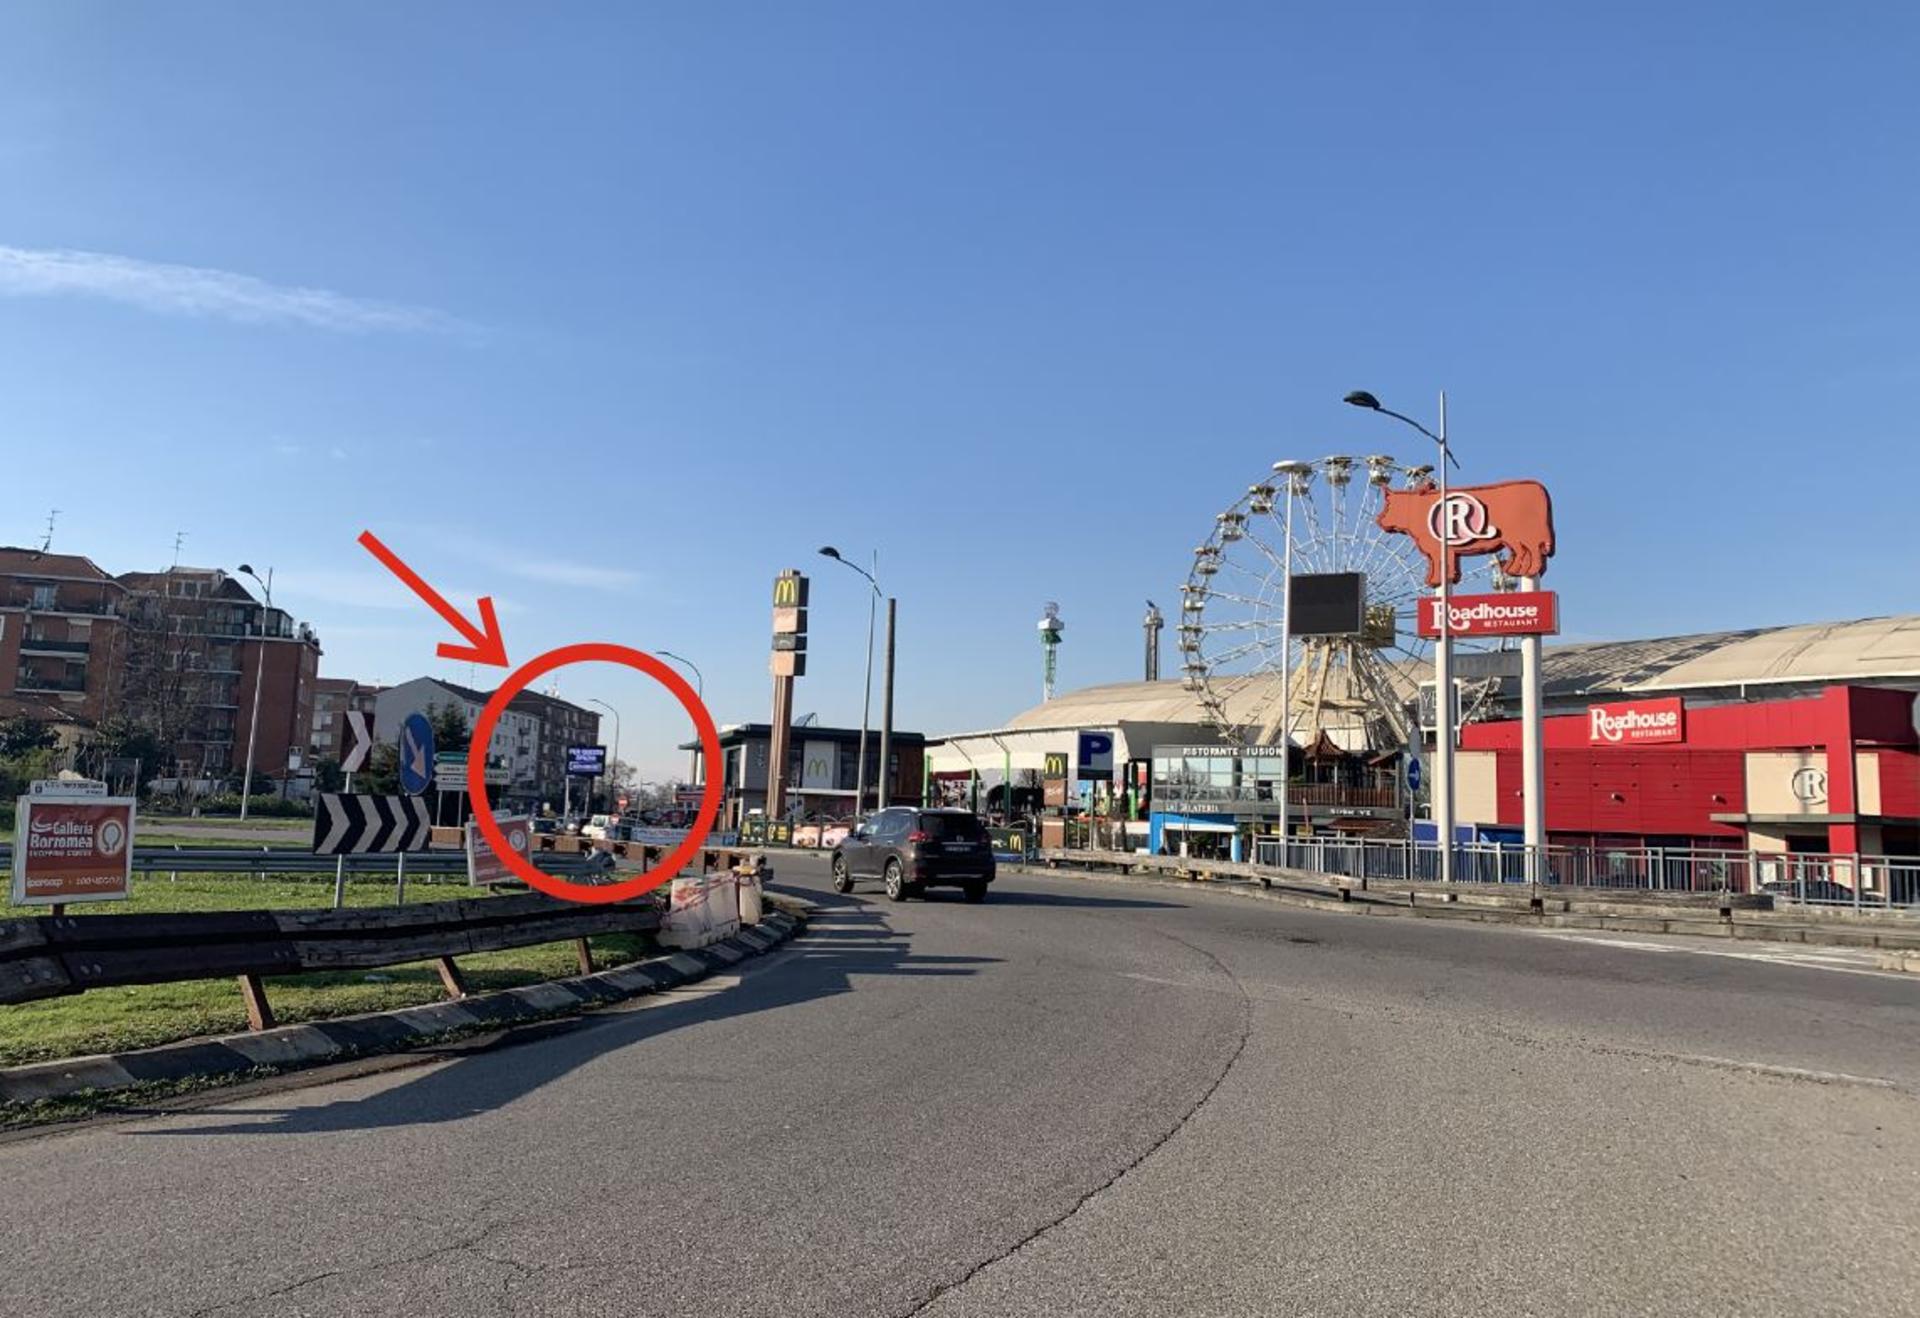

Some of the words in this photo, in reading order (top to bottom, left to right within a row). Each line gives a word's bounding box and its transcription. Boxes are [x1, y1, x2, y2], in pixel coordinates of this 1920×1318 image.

[1483, 618, 1539, 628] RESTAURANT
[1589, 708, 1678, 741] Roadhouse
[1631, 728, 1678, 738] RESTAURANT
[1079, 734, 1112, 766] P
[1183, 747, 1239, 757] RISTORANTE
[53, 820, 93, 835] Galleria
[30, 834, 93, 849] Borromea
